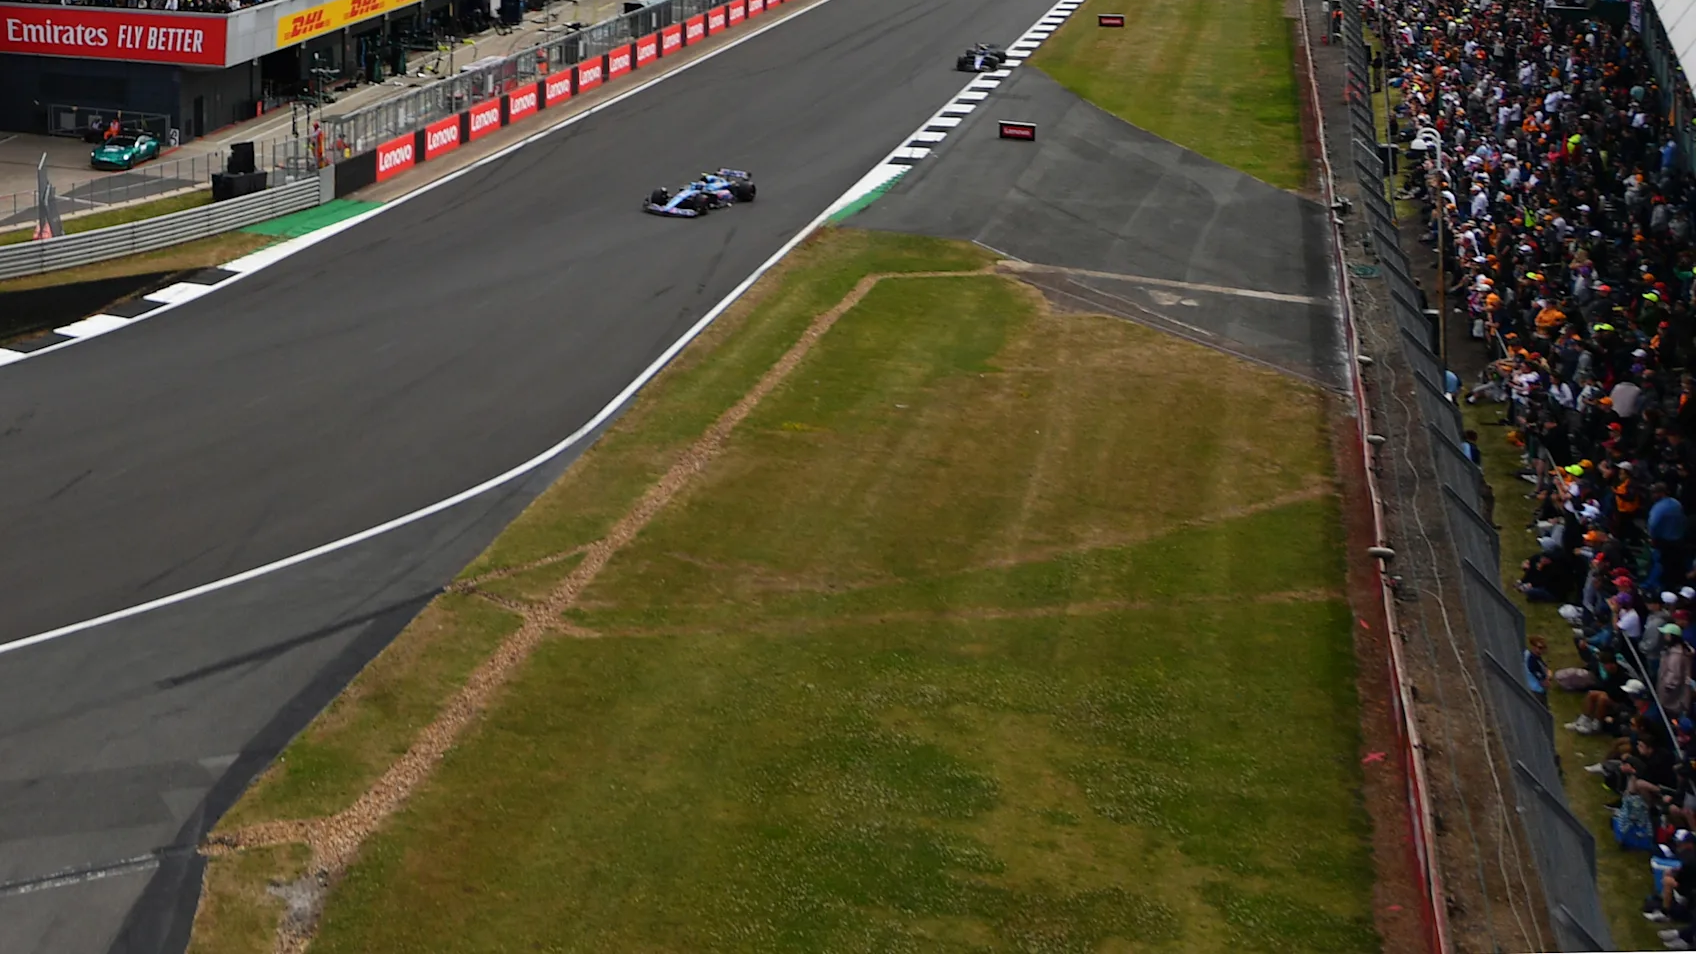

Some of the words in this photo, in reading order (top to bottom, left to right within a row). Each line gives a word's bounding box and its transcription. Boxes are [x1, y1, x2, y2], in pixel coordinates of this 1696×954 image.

[6, 18, 108, 47] Emirates
[117, 24, 144, 50] FLY
[147, 27, 203, 53] BETTER
[579, 66, 602, 86] Lenovo
[546, 79, 571, 100] Lenovo
[510, 93, 536, 115] Lenovo
[471, 107, 499, 132] Lenovo
[427, 125, 458, 151] Lenovo
[379, 144, 412, 172] Lenovo
